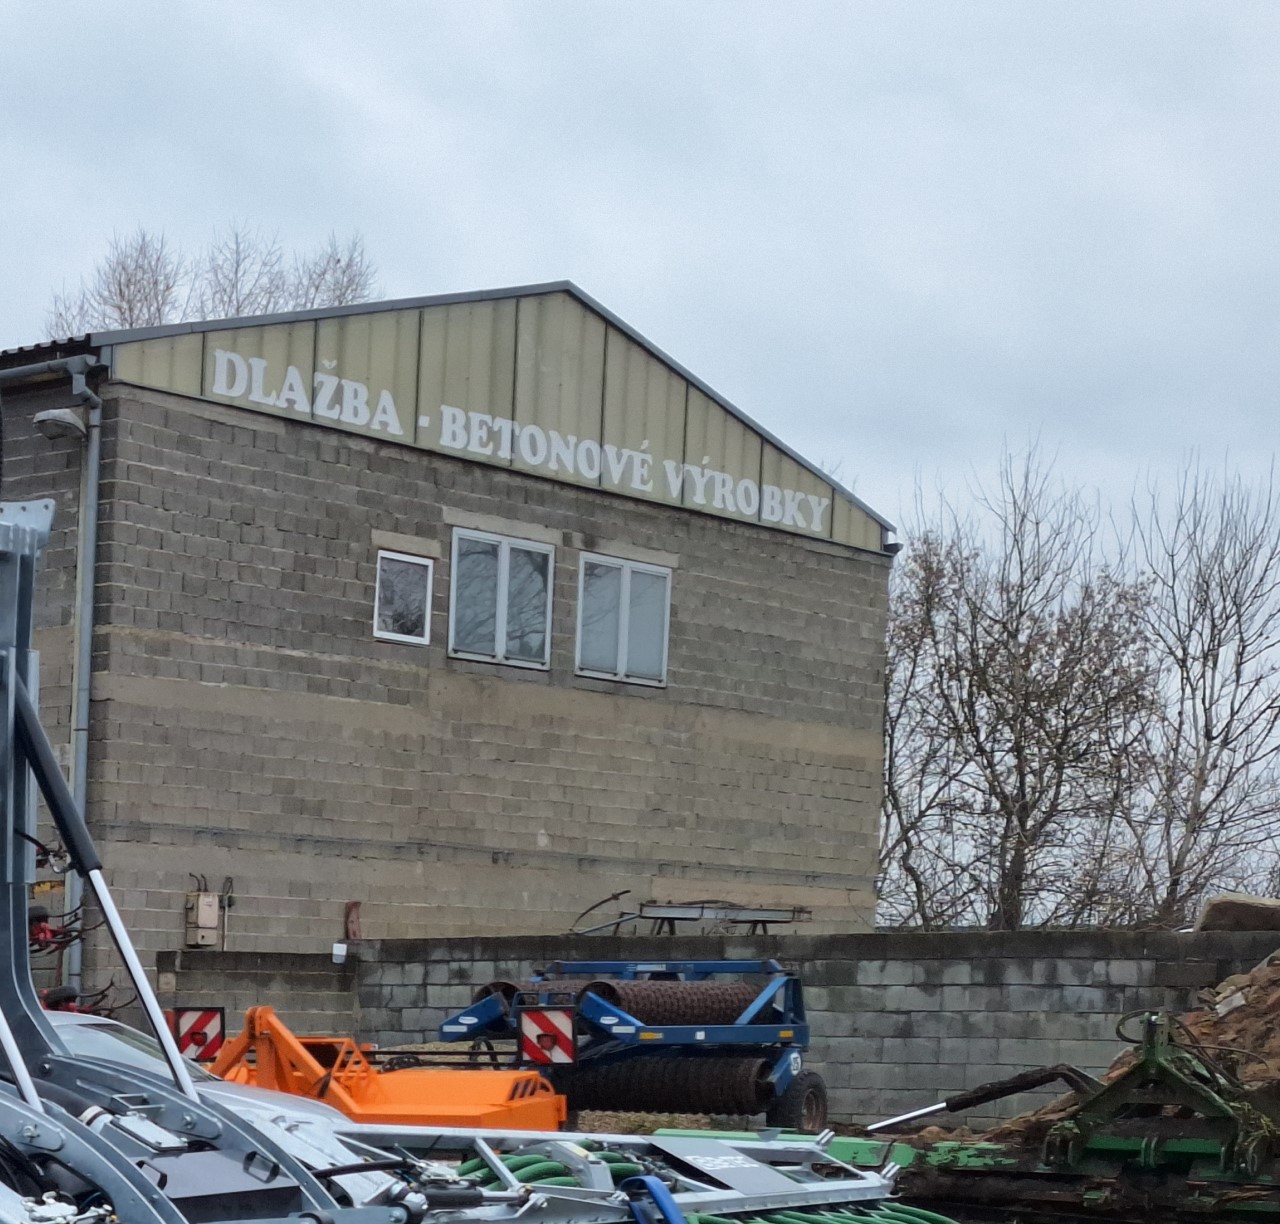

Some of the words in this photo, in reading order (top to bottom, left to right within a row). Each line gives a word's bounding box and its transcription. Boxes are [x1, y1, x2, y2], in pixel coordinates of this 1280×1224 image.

[212, 348, 403, 435] DLAŽBA
[440, 404, 654, 493] BETONOVÉ
[663, 456, 833, 532] VÝROBKY
